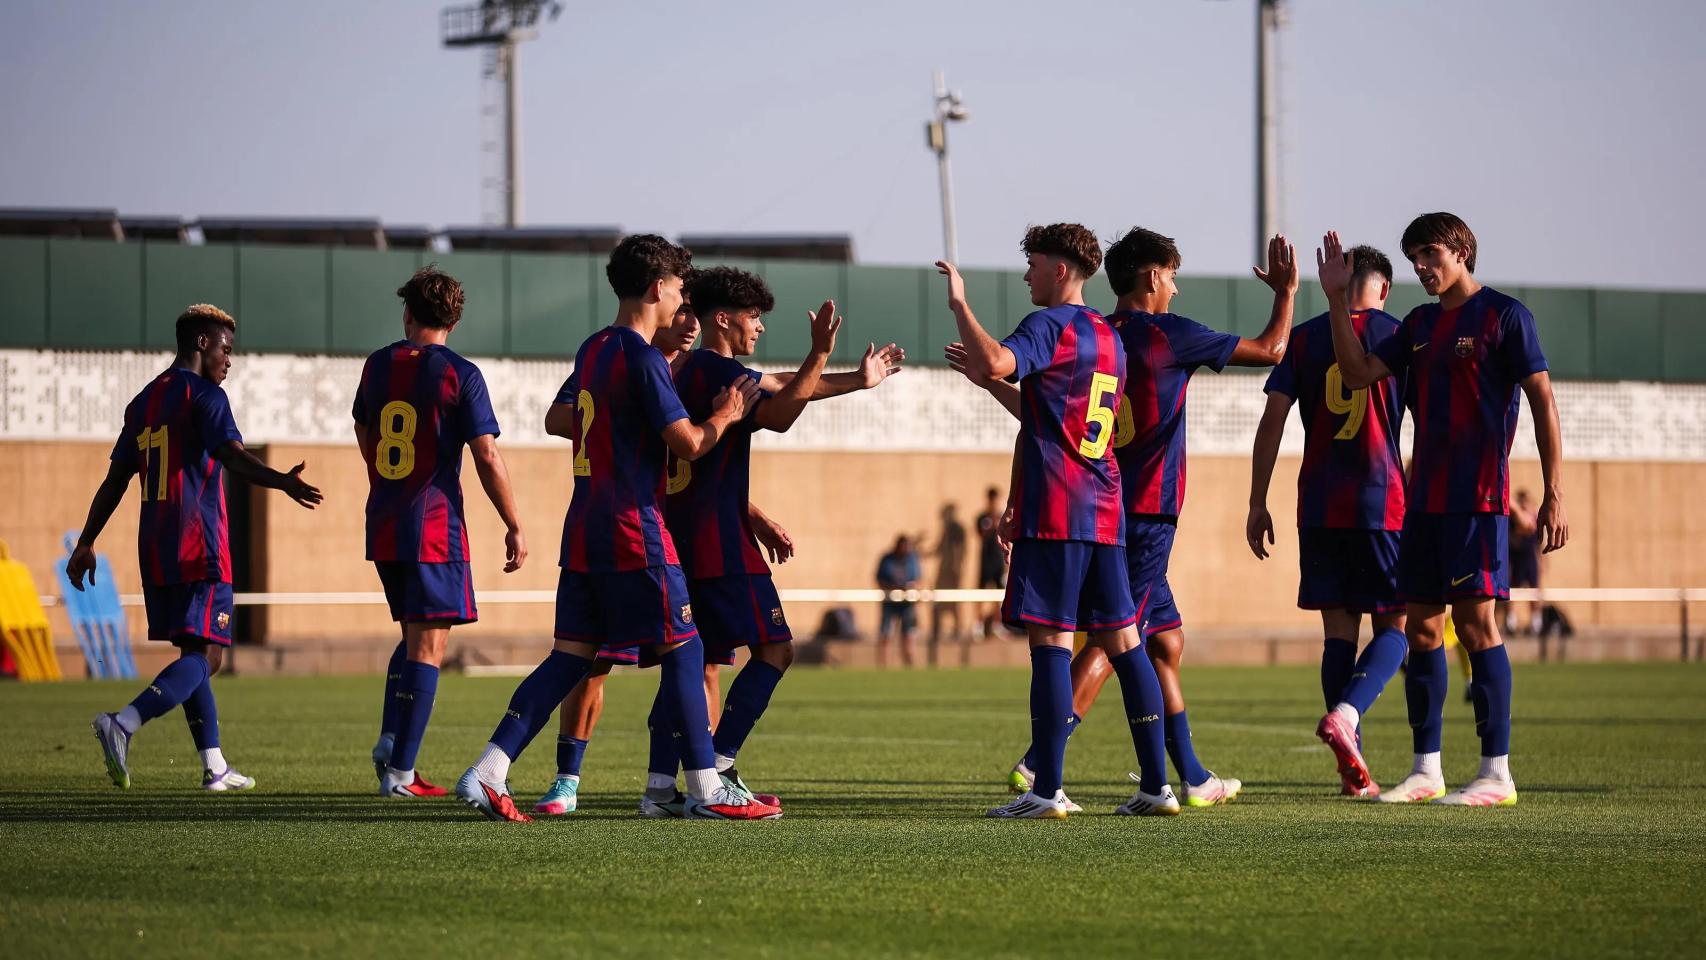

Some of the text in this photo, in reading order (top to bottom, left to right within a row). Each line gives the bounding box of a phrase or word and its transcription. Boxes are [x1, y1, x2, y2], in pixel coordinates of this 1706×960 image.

[376, 401, 417, 479] 8
[574, 390, 594, 476] 2
[1079, 372, 1118, 459] 5
[1326, 363, 1367, 439] 9
[137, 425, 168, 501] 11
